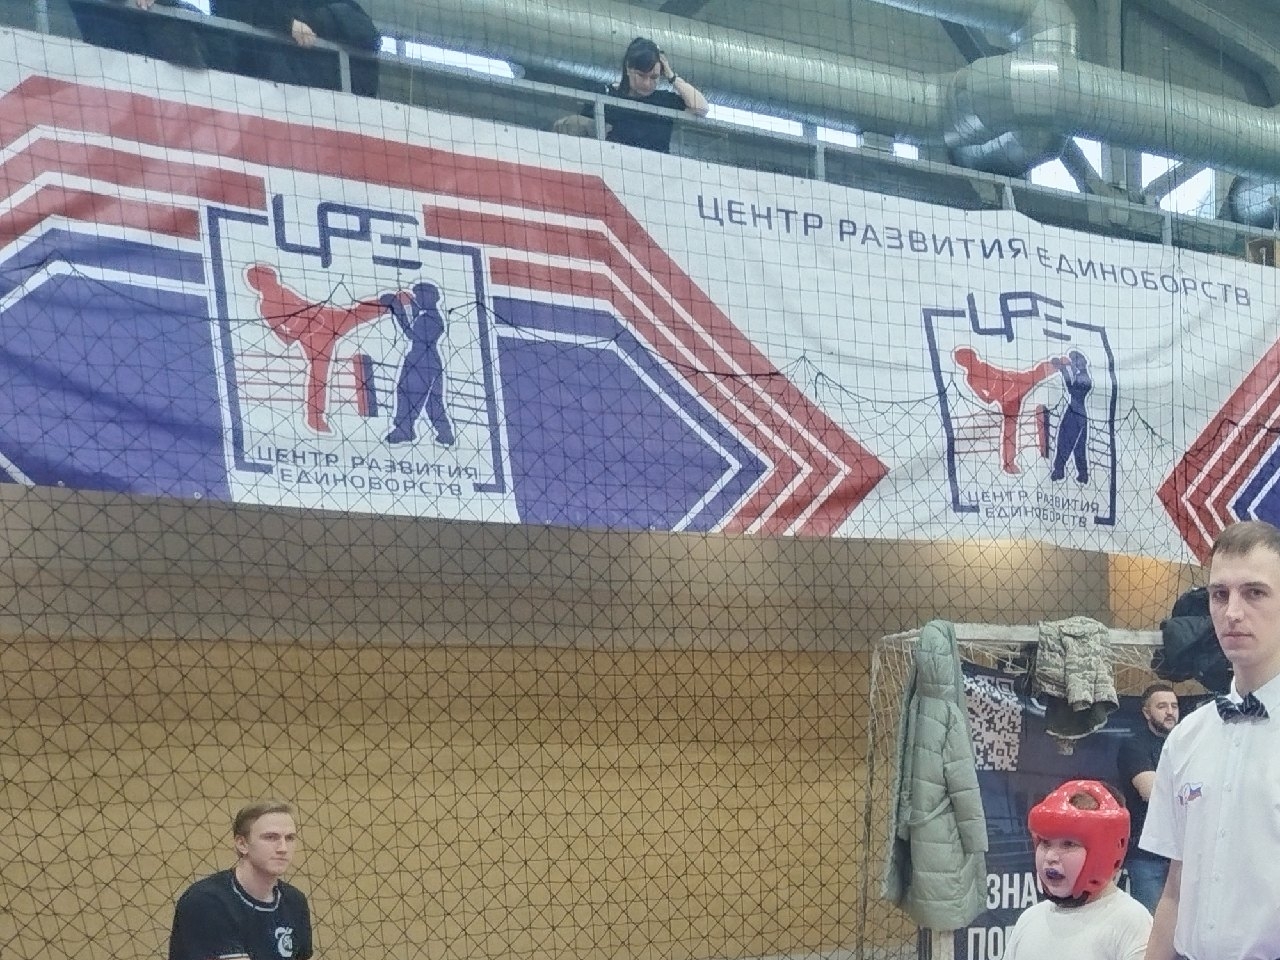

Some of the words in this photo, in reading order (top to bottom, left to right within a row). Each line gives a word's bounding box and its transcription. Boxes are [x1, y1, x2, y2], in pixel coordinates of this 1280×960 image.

[697, 194, 824, 237] ЦЕНТР
[839, 218, 1030, 261] РАЗВИТИЯ
[1036, 246, 1251, 307] ЕДИНОБОРСТВ
[257, 445, 339, 468] ЦЕНТР
[351, 455, 478, 480] РАЗВИТИЯ
[280, 468, 463, 496] ЕДИНОБОРСТВ
[967, 490, 1029, 504] ЦЕНТР
[1036, 491, 1100, 514] РАЗВИТИЯ
[985, 505, 1088, 528] ЕДИНОБОРСТВ
